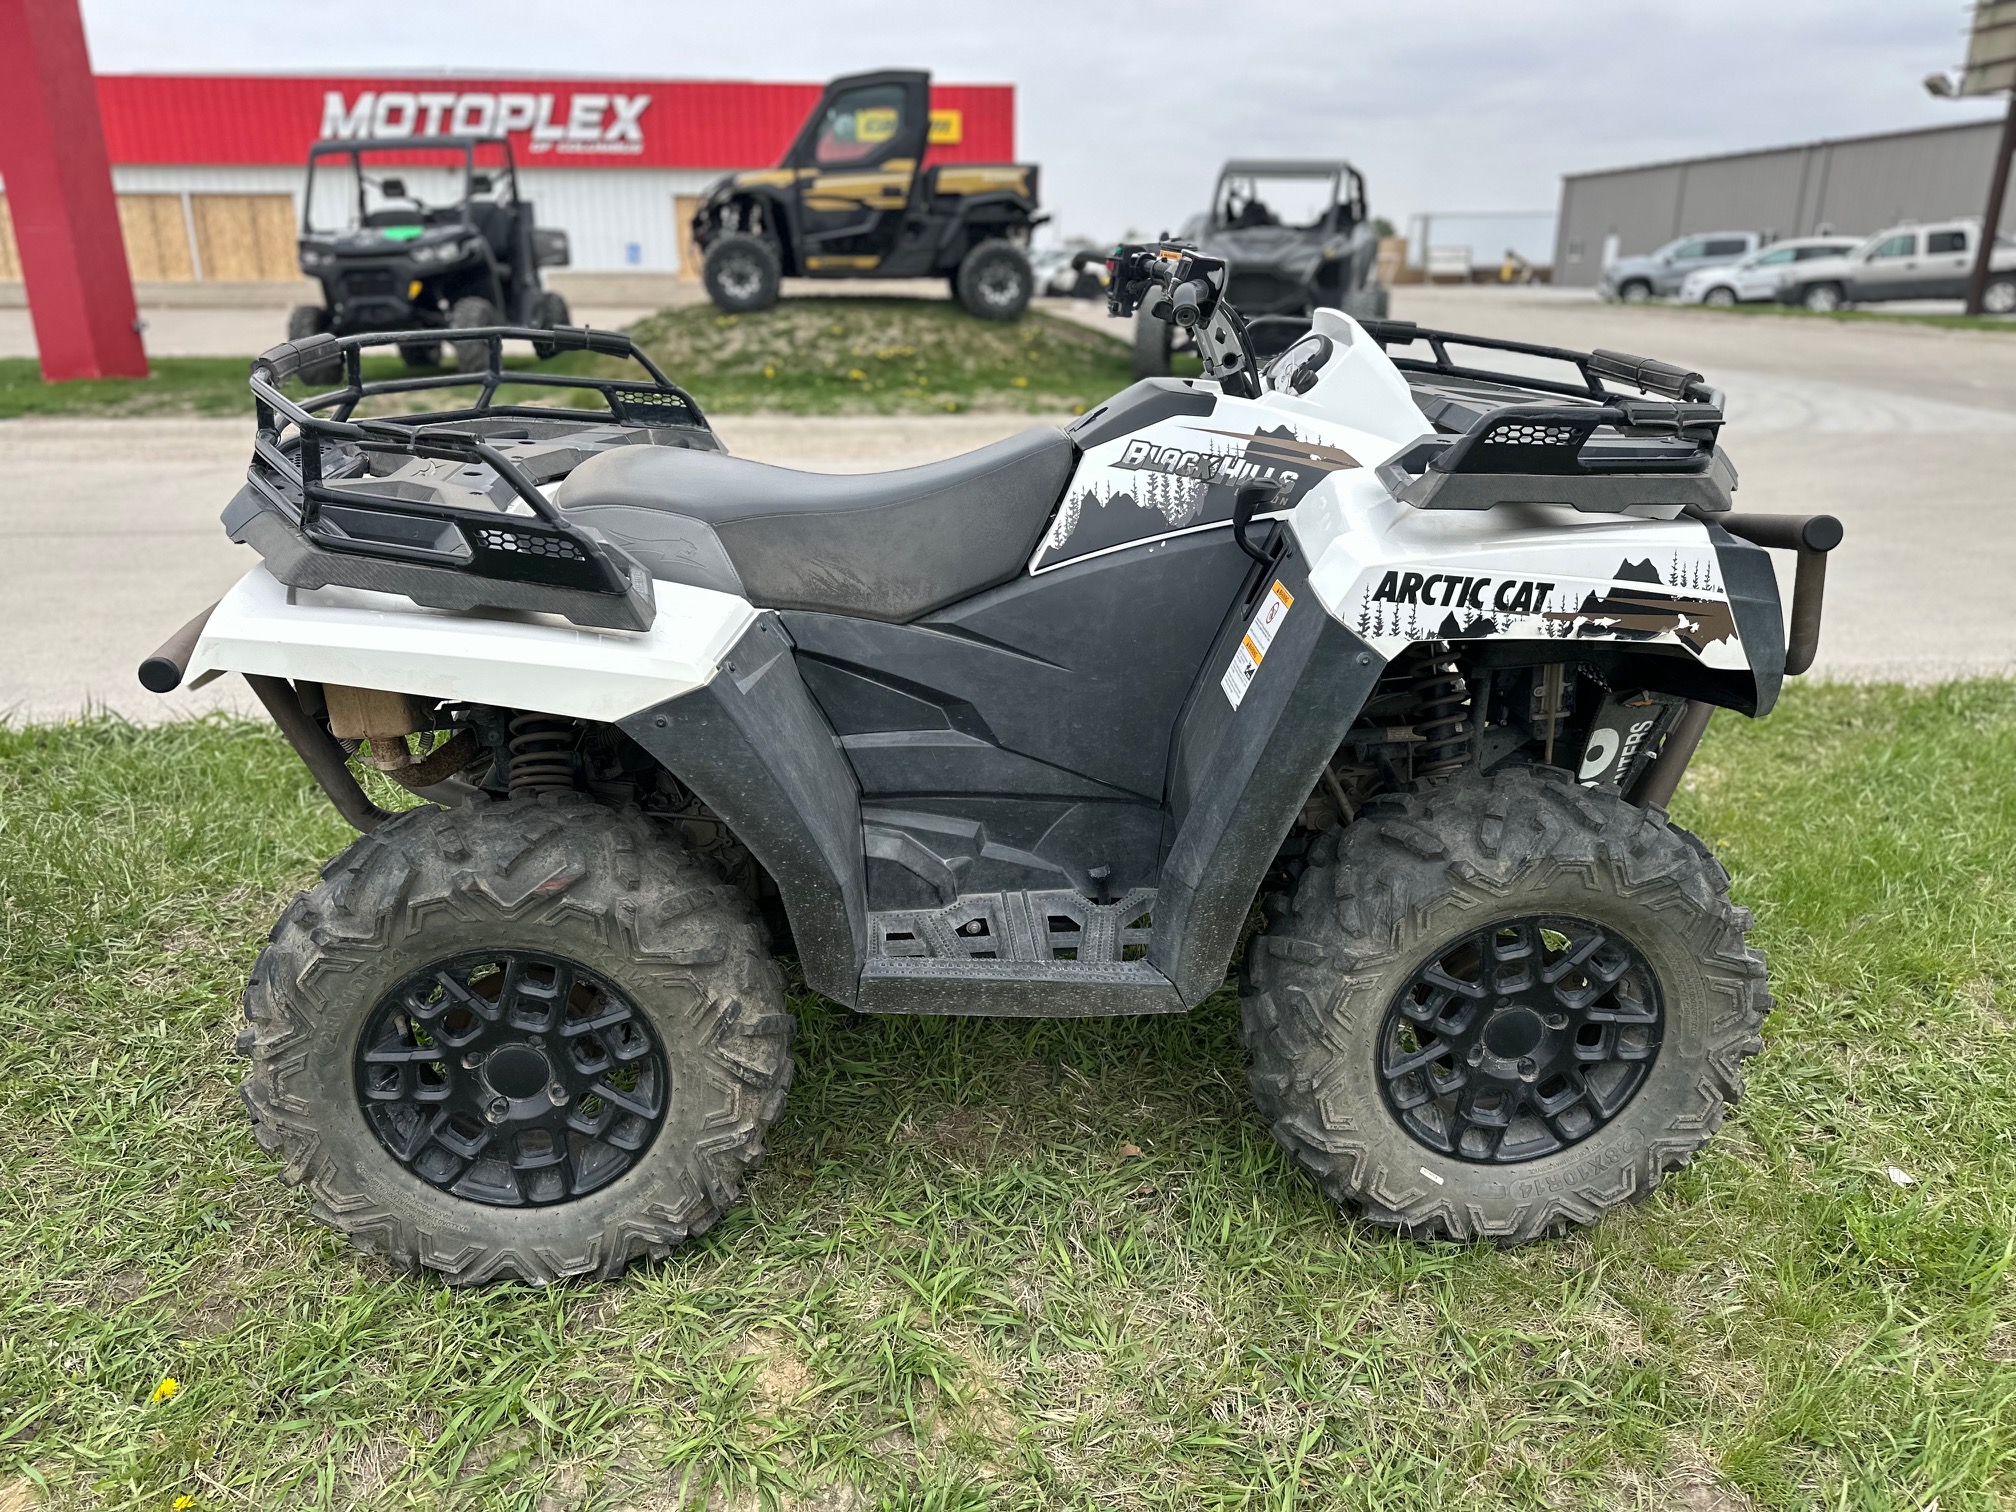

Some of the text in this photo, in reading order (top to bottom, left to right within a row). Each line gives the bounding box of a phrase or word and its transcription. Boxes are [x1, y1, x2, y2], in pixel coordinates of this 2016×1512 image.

[321, 92, 651, 140] MOTOPLEX
[1108, 439, 1221, 480] BLACK
[1371, 570, 1555, 615] ARCTIC CAT
